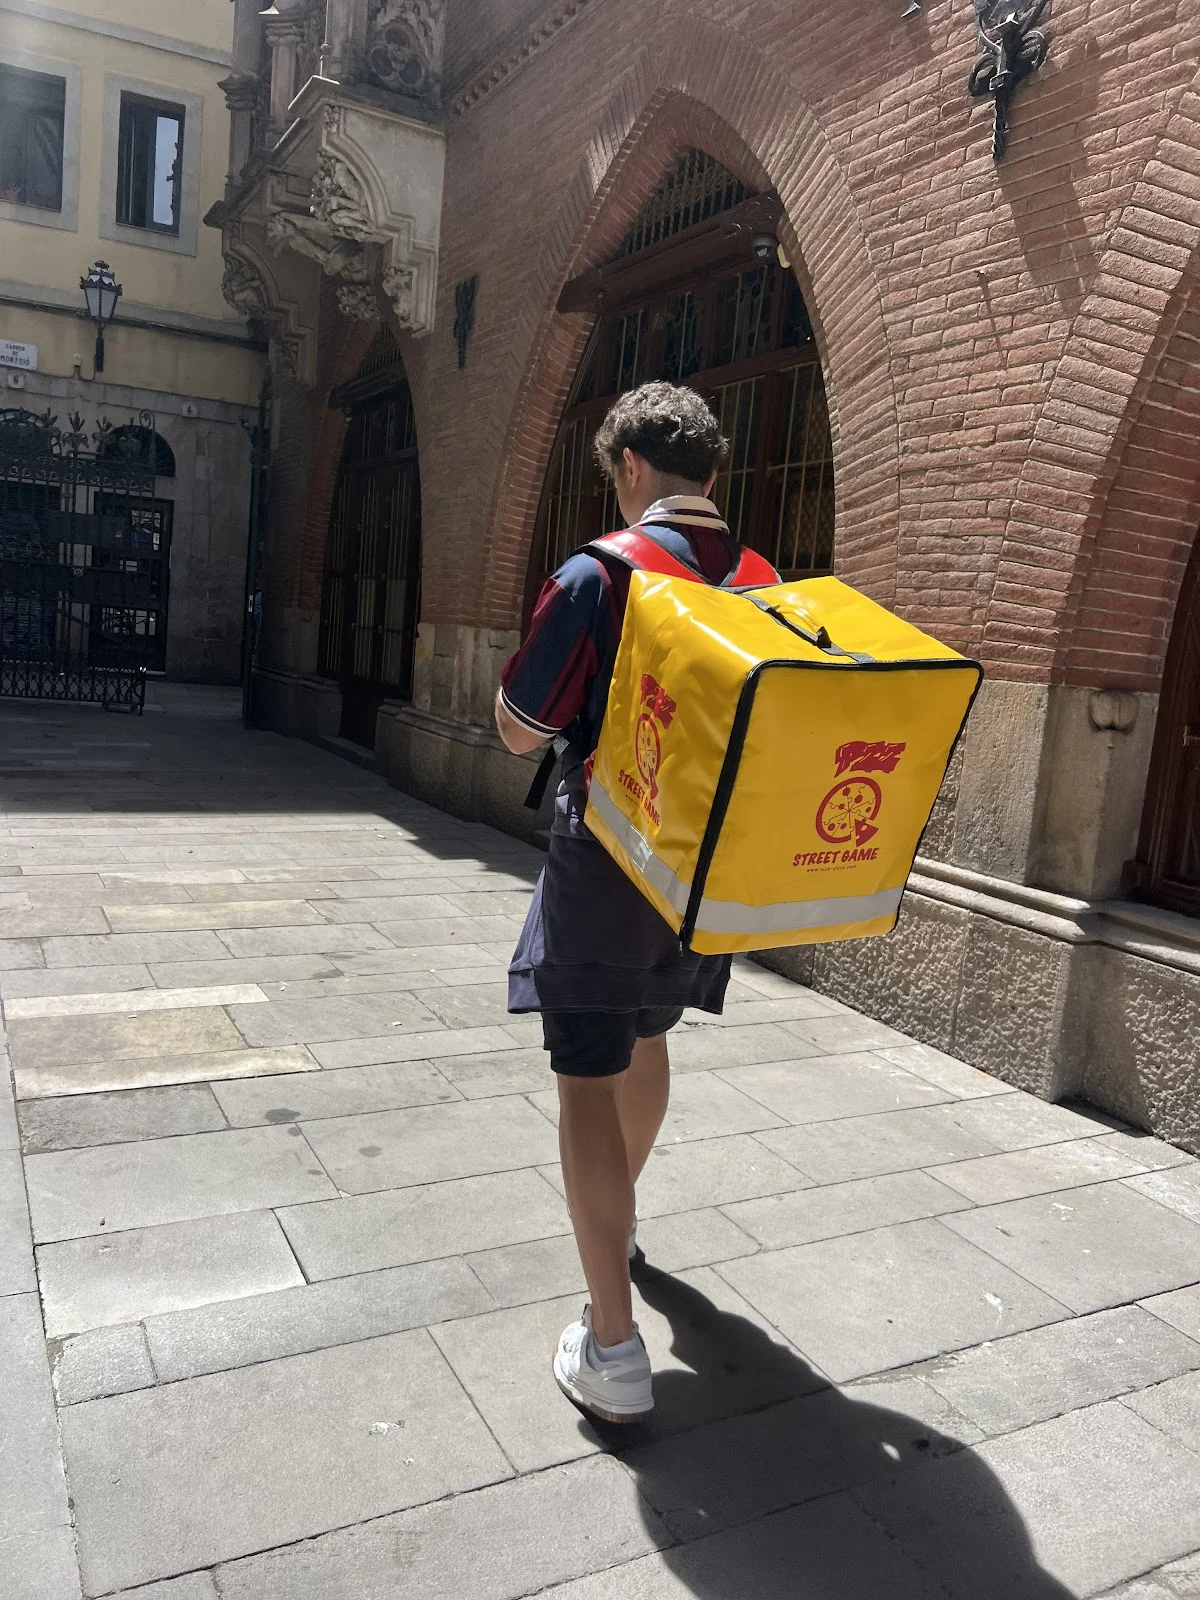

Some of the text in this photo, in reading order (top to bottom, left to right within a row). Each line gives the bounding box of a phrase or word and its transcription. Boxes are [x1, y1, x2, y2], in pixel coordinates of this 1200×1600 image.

[186, 404, 192, 416] 4
[618, 769, 645, 801] STREET
[644, 796, 660, 827] GAME
[793, 847, 880, 867] STREET GAME
